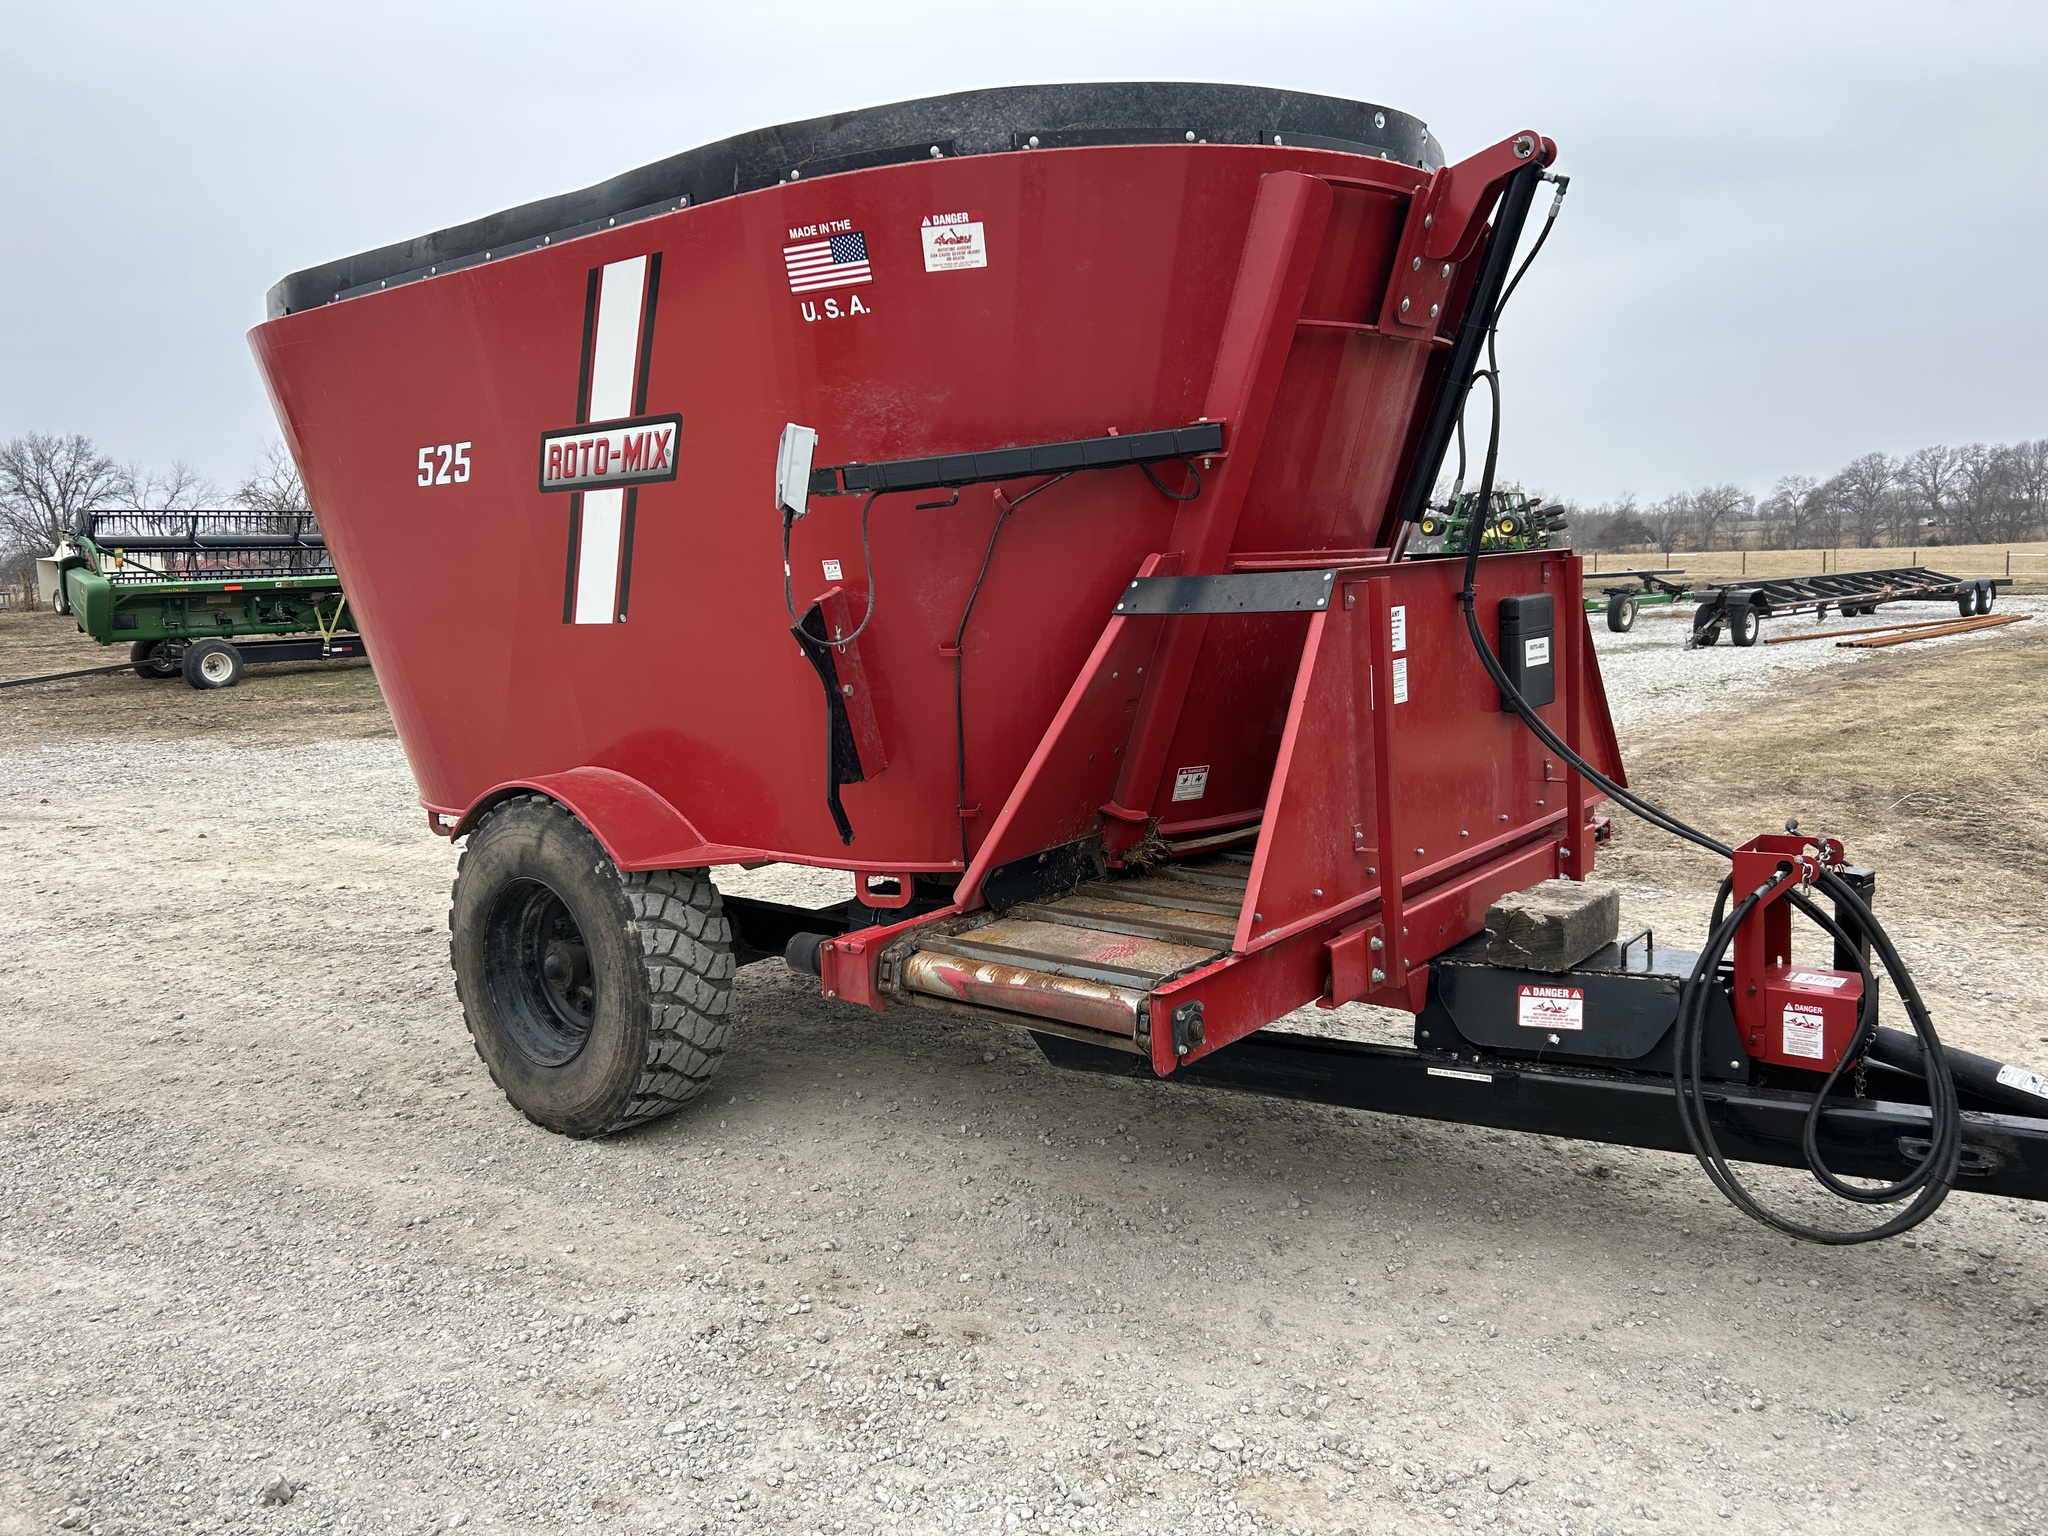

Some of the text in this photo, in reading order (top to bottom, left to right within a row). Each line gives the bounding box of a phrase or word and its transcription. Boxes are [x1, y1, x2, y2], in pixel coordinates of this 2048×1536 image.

[932, 212, 969, 226] DANGER
[788, 219, 852, 239] MADE IN THE
[547, 429, 672, 480] ROTO-MIX
[417, 441, 472, 487] 525
[1532, 987, 1570, 998] DANGER
[1794, 1003, 1823, 1014] DANGER
